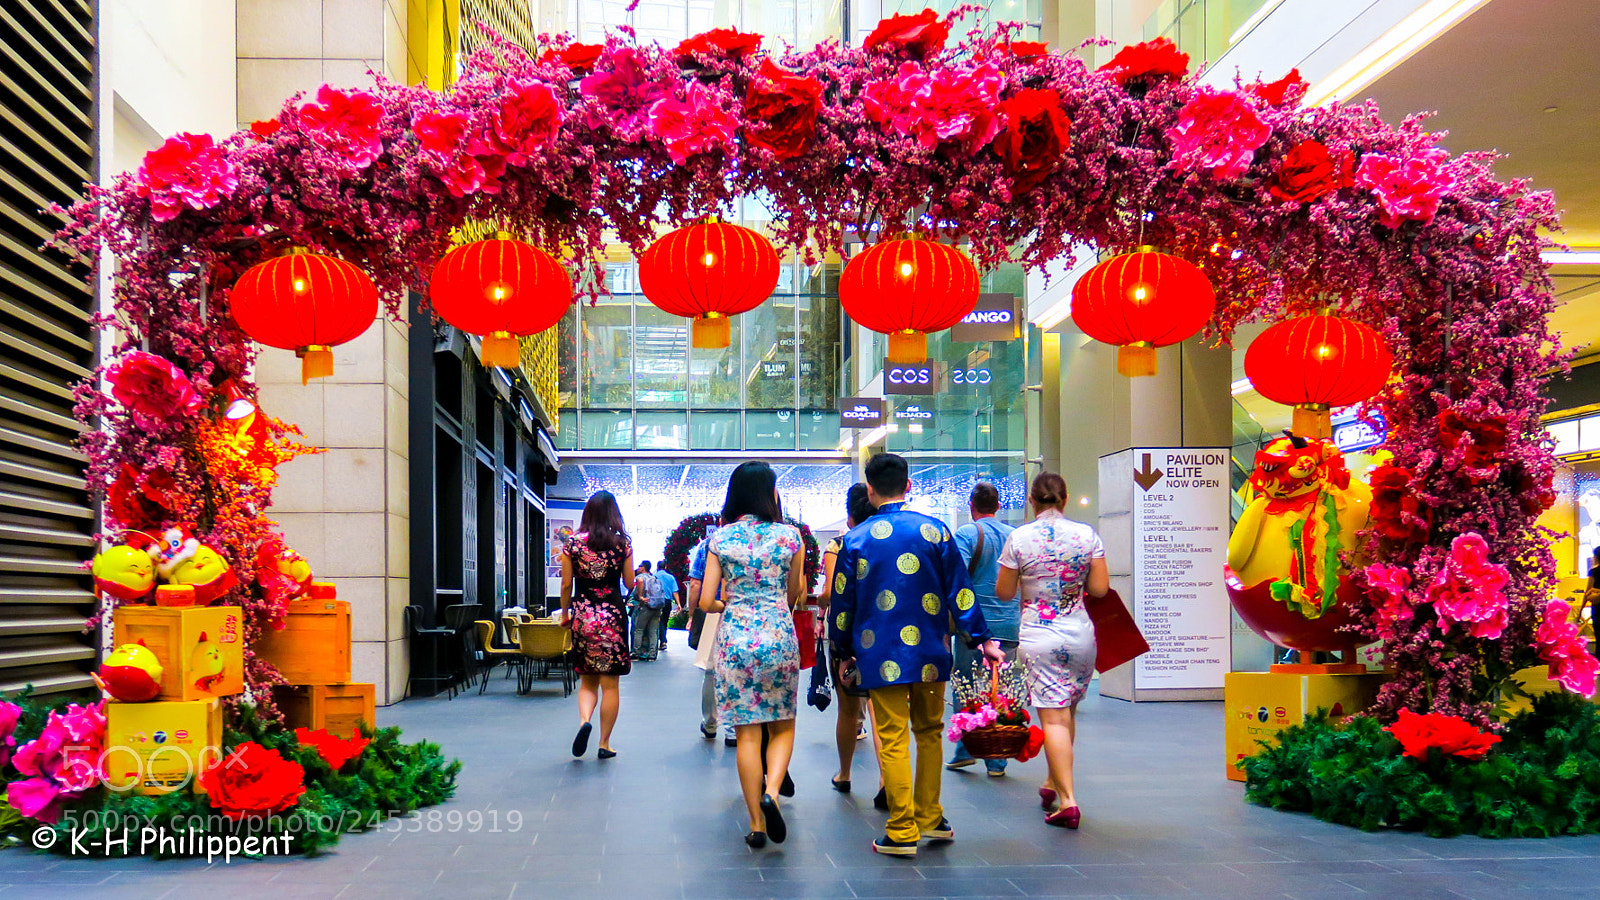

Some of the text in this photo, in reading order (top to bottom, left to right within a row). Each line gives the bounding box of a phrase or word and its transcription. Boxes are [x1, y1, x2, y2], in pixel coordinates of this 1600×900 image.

[888, 368, 930, 384] COS
[842, 411, 880, 419] COACH
[1166, 454, 1225, 466] PAVILION
[1166, 467, 1203, 478] ELITE
[1166, 480, 1220, 488] NOW OPEN
[1143, 494, 1168, 502] LEVEL
[1143, 534, 1168, 542] LEVEL
